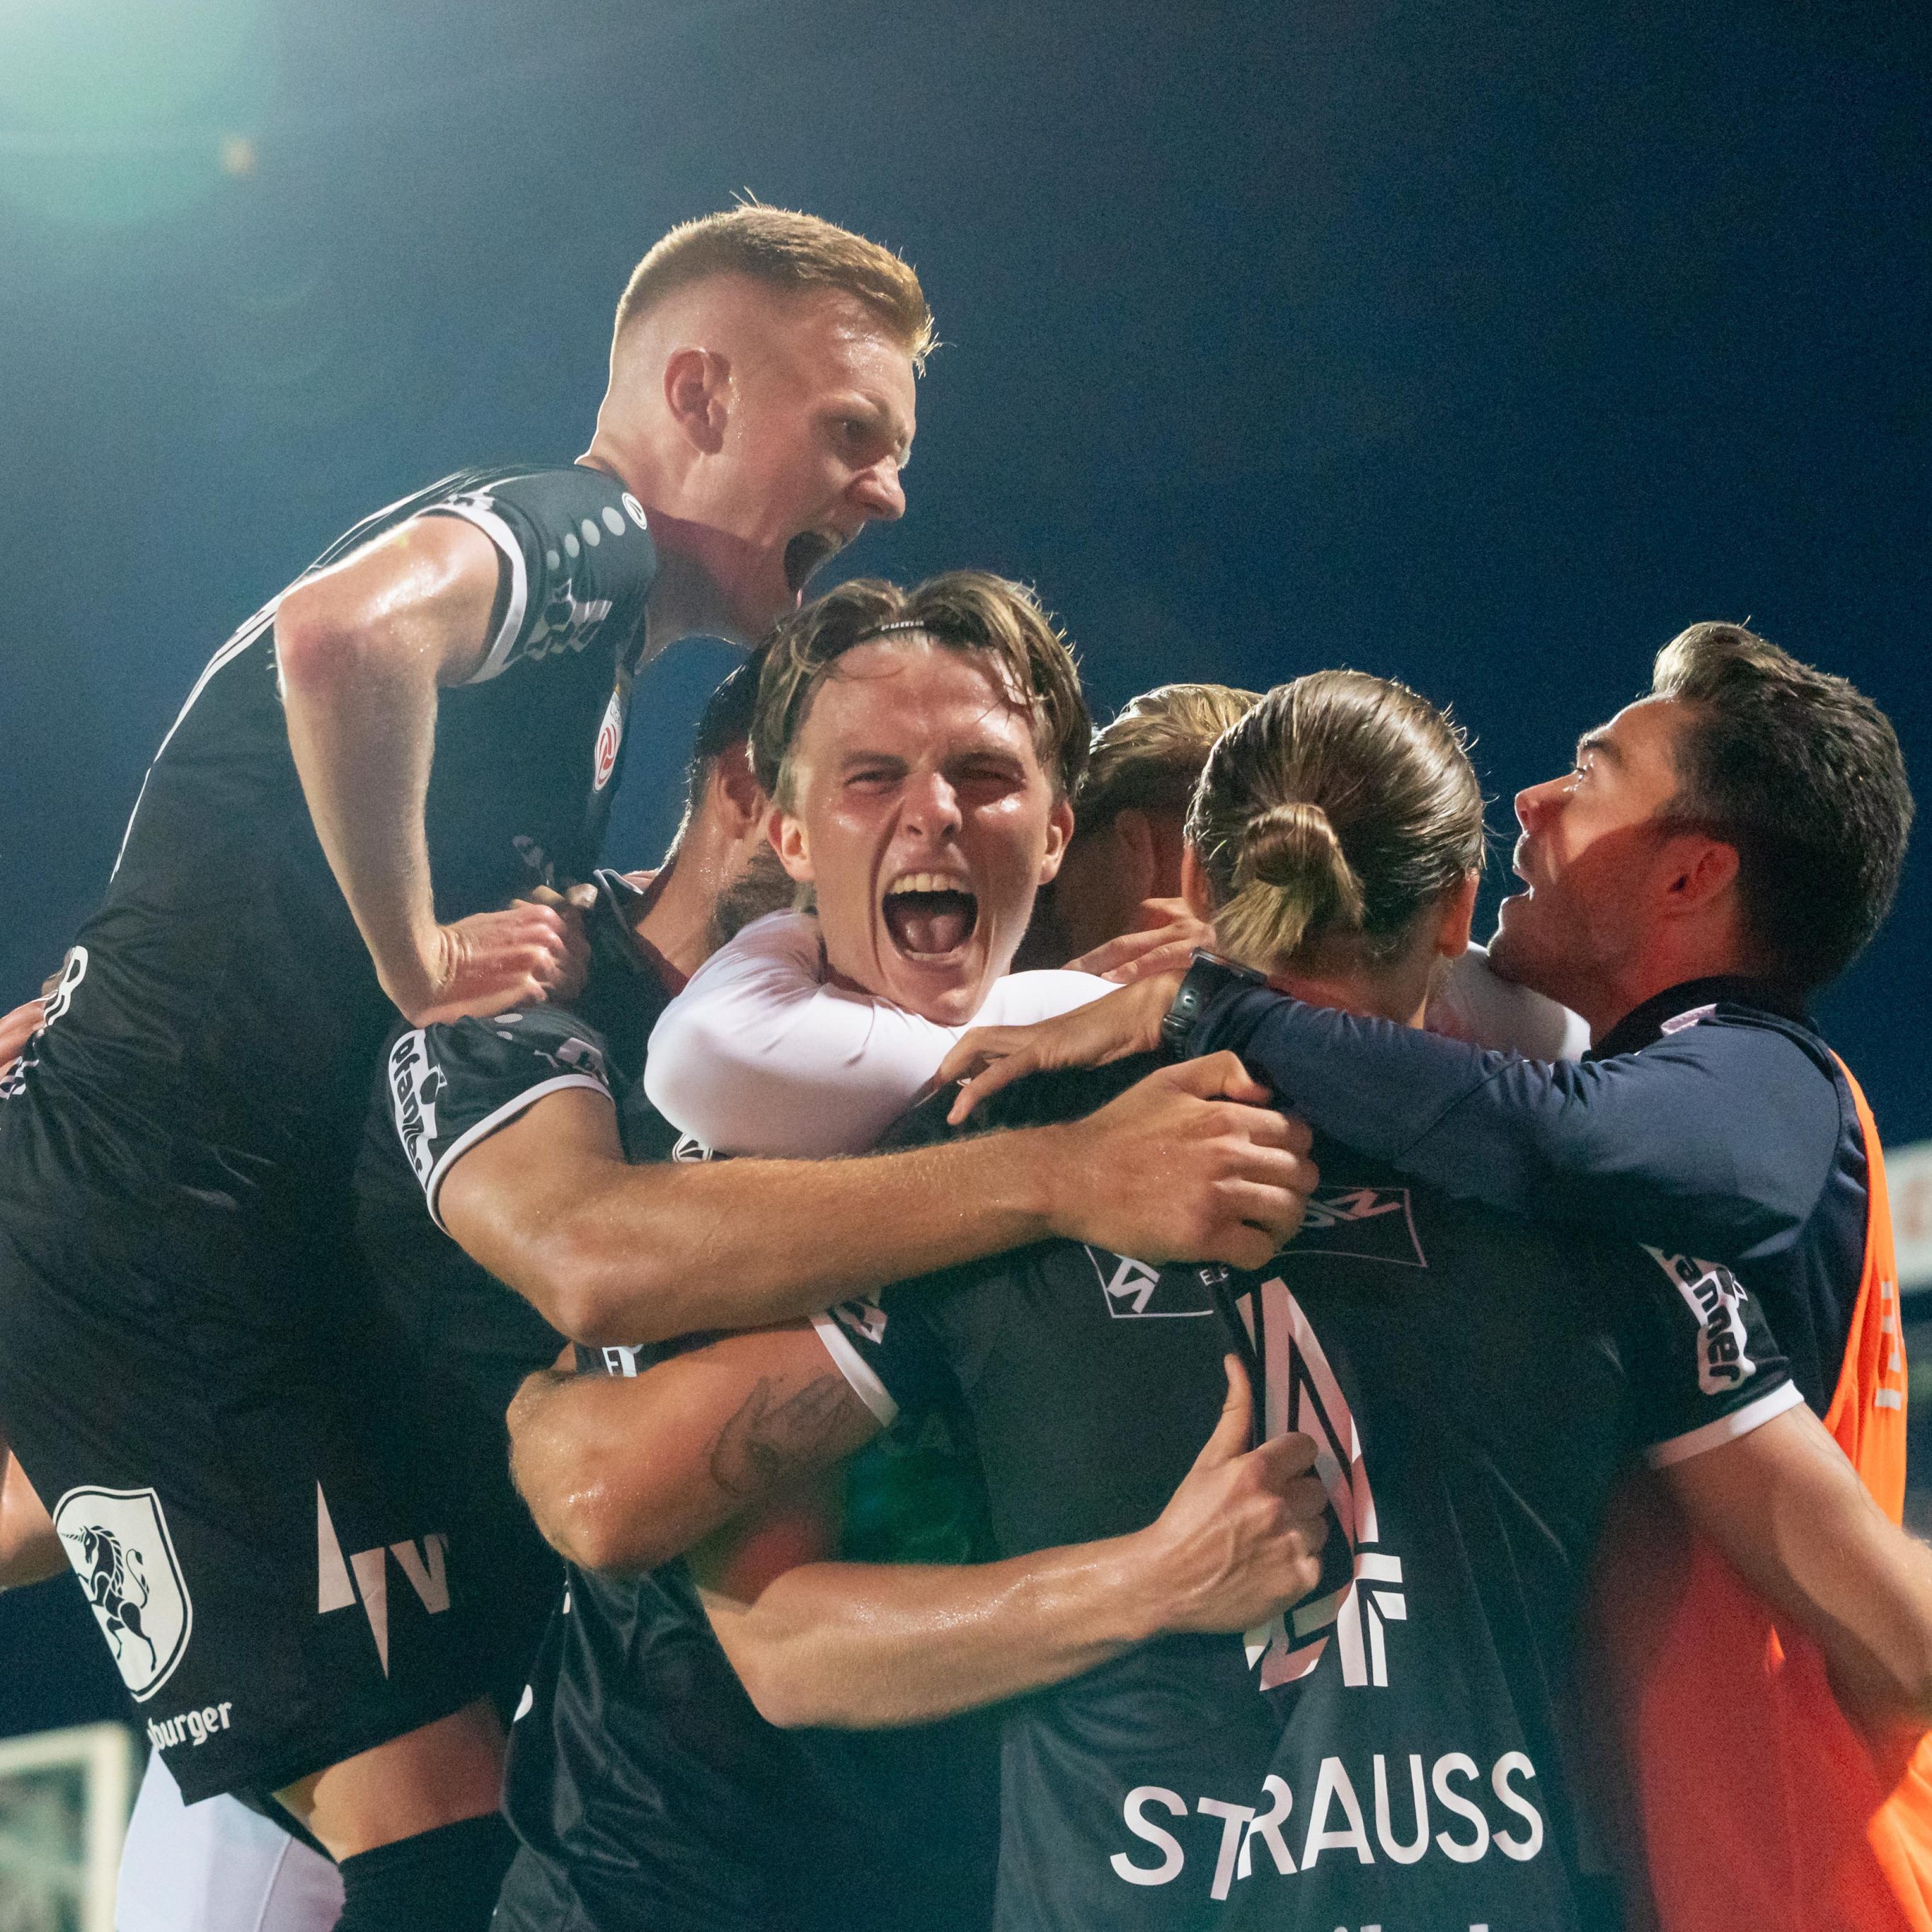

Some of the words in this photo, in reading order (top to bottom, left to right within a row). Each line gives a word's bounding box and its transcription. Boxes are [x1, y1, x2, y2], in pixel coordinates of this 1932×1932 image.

[1675, 1257, 1741, 1382] anner
[146, 1701, 233, 1750] burger
[1110, 1751, 1544, 1901] STRAUSS
